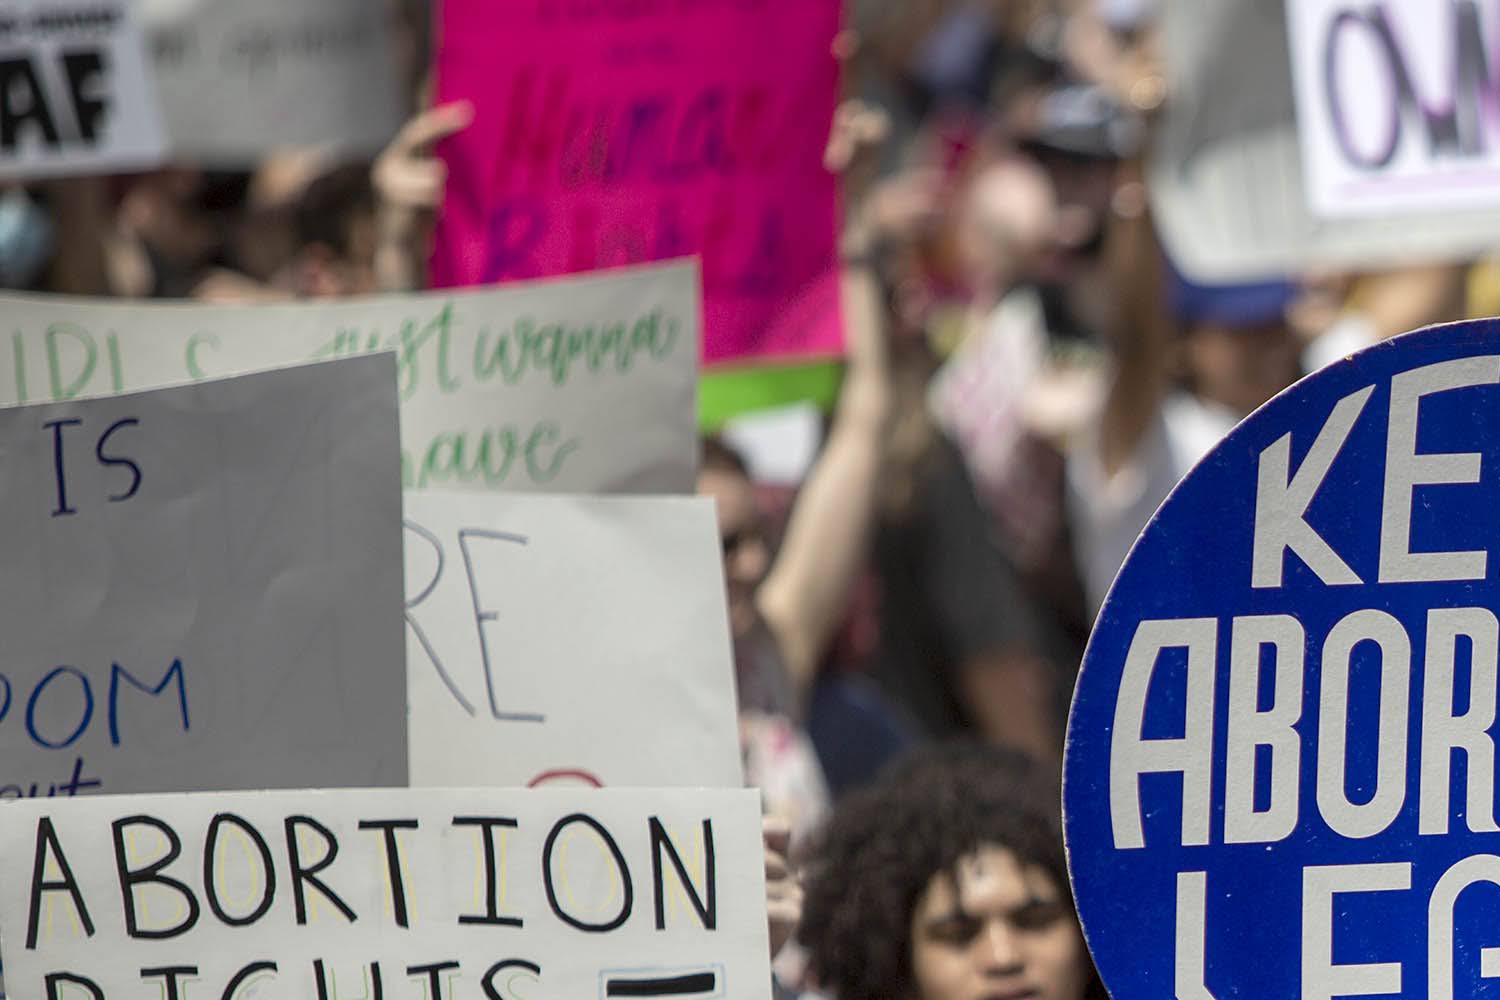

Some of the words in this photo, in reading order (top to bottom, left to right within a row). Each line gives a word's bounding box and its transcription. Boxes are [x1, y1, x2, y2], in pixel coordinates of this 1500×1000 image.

[472, 306, 682, 386] wanna
[43, 417, 143, 519] IS
[25, 812, 717, 950] ABORTION
